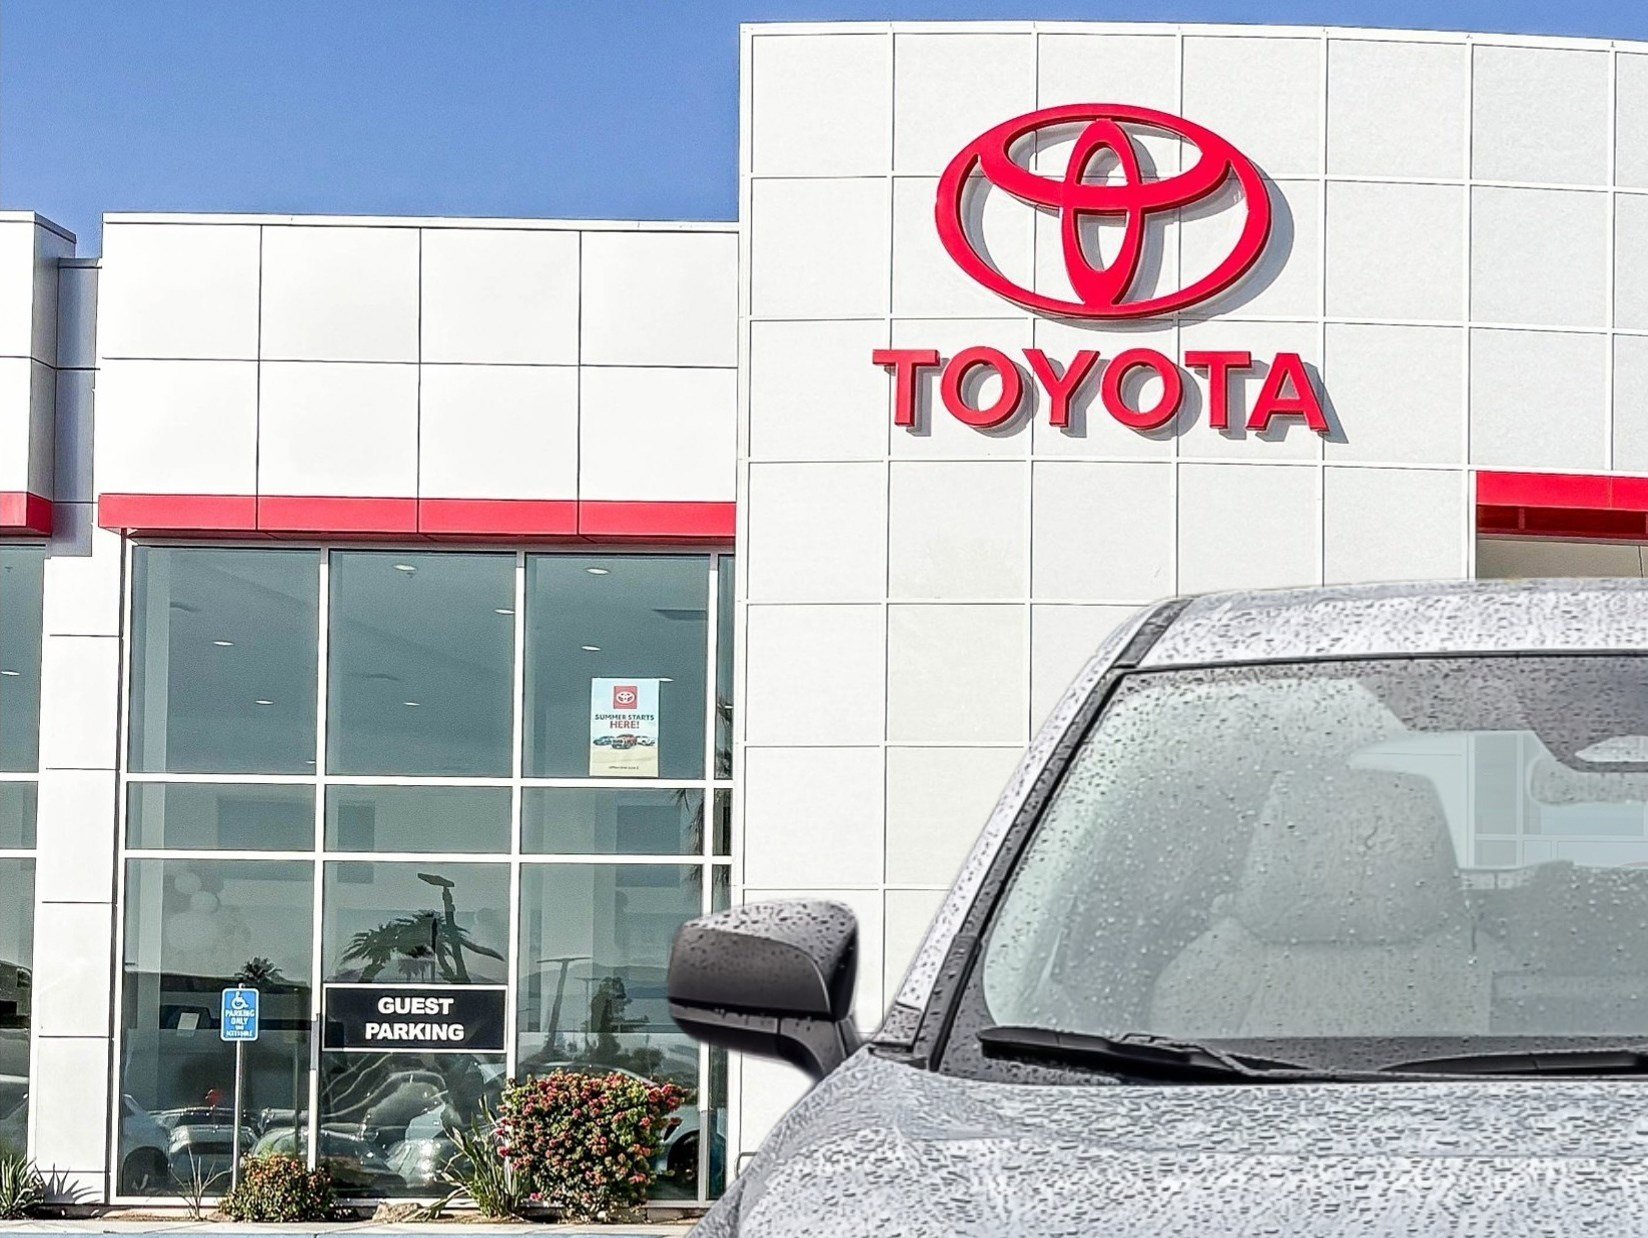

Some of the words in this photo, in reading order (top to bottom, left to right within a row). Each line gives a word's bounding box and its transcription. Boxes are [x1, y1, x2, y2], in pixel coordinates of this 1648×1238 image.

[872, 346, 1330, 433] TOYOTA
[610, 721, 640, 729] HERE!
[377, 997, 454, 1015] GUEST
[365, 1022, 465, 1041] PARKING
